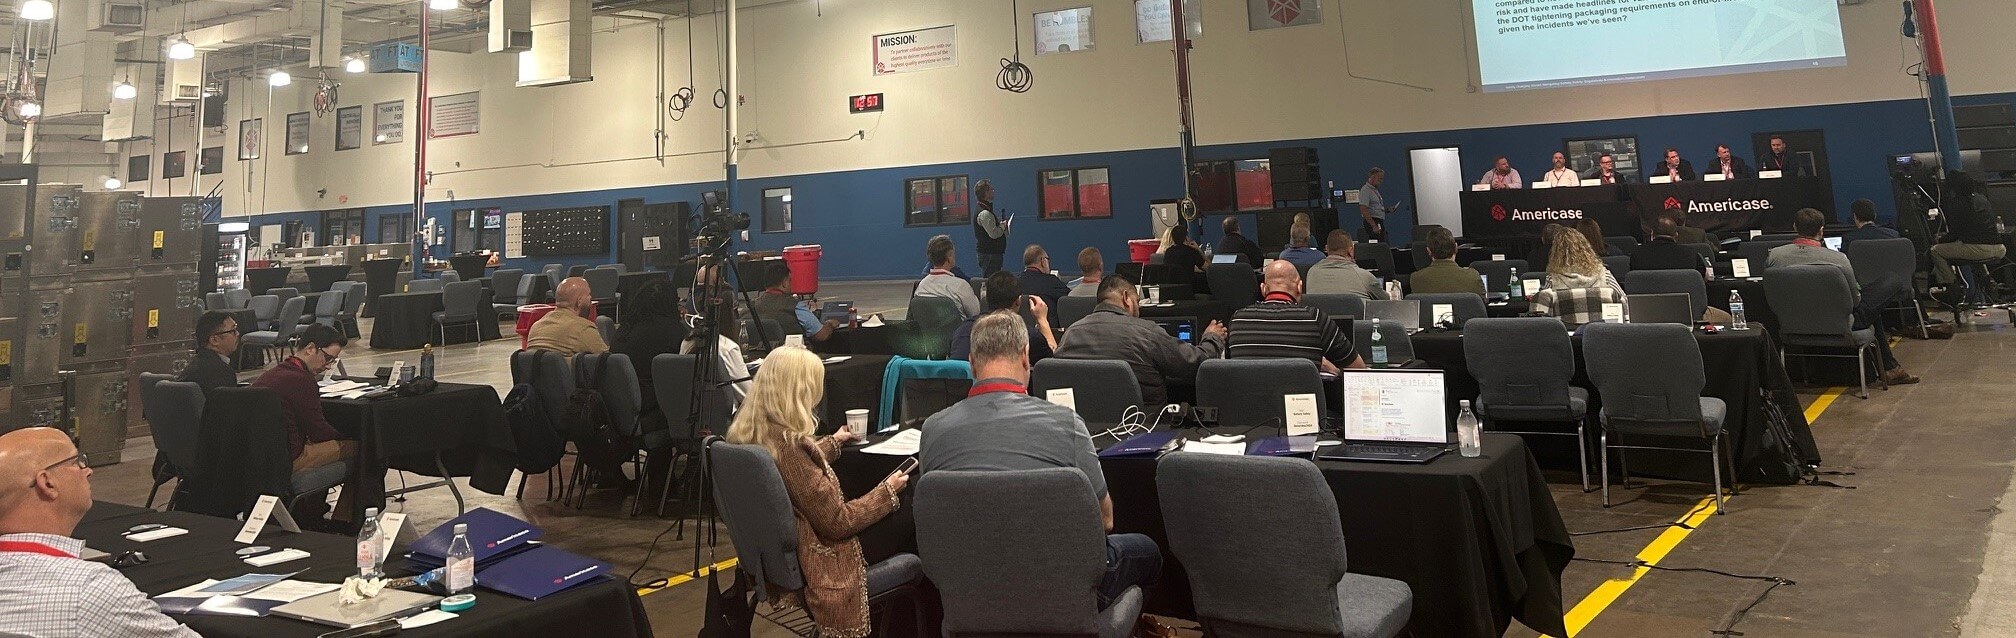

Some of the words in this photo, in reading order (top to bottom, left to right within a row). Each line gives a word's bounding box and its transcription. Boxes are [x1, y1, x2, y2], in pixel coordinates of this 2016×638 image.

[1512, 15, 1529, 24] DOT
[1531, 12, 1573, 22] tightening
[1574, 8, 1618, 18] packaging
[1619, 2, 1676, 13] requirements
[1530, 5, 1550, 13] have
[1551, 3, 1574, 11] made
[1498, 26, 1520, 35] given
[1537, 20, 1574, 30] incidents
[1576, 18, 1600, 26] we've
[1602, 14, 1628, 24] seen?
[880, 35, 918, 47] MISSION:
[1512, 207, 1583, 221] Americase
